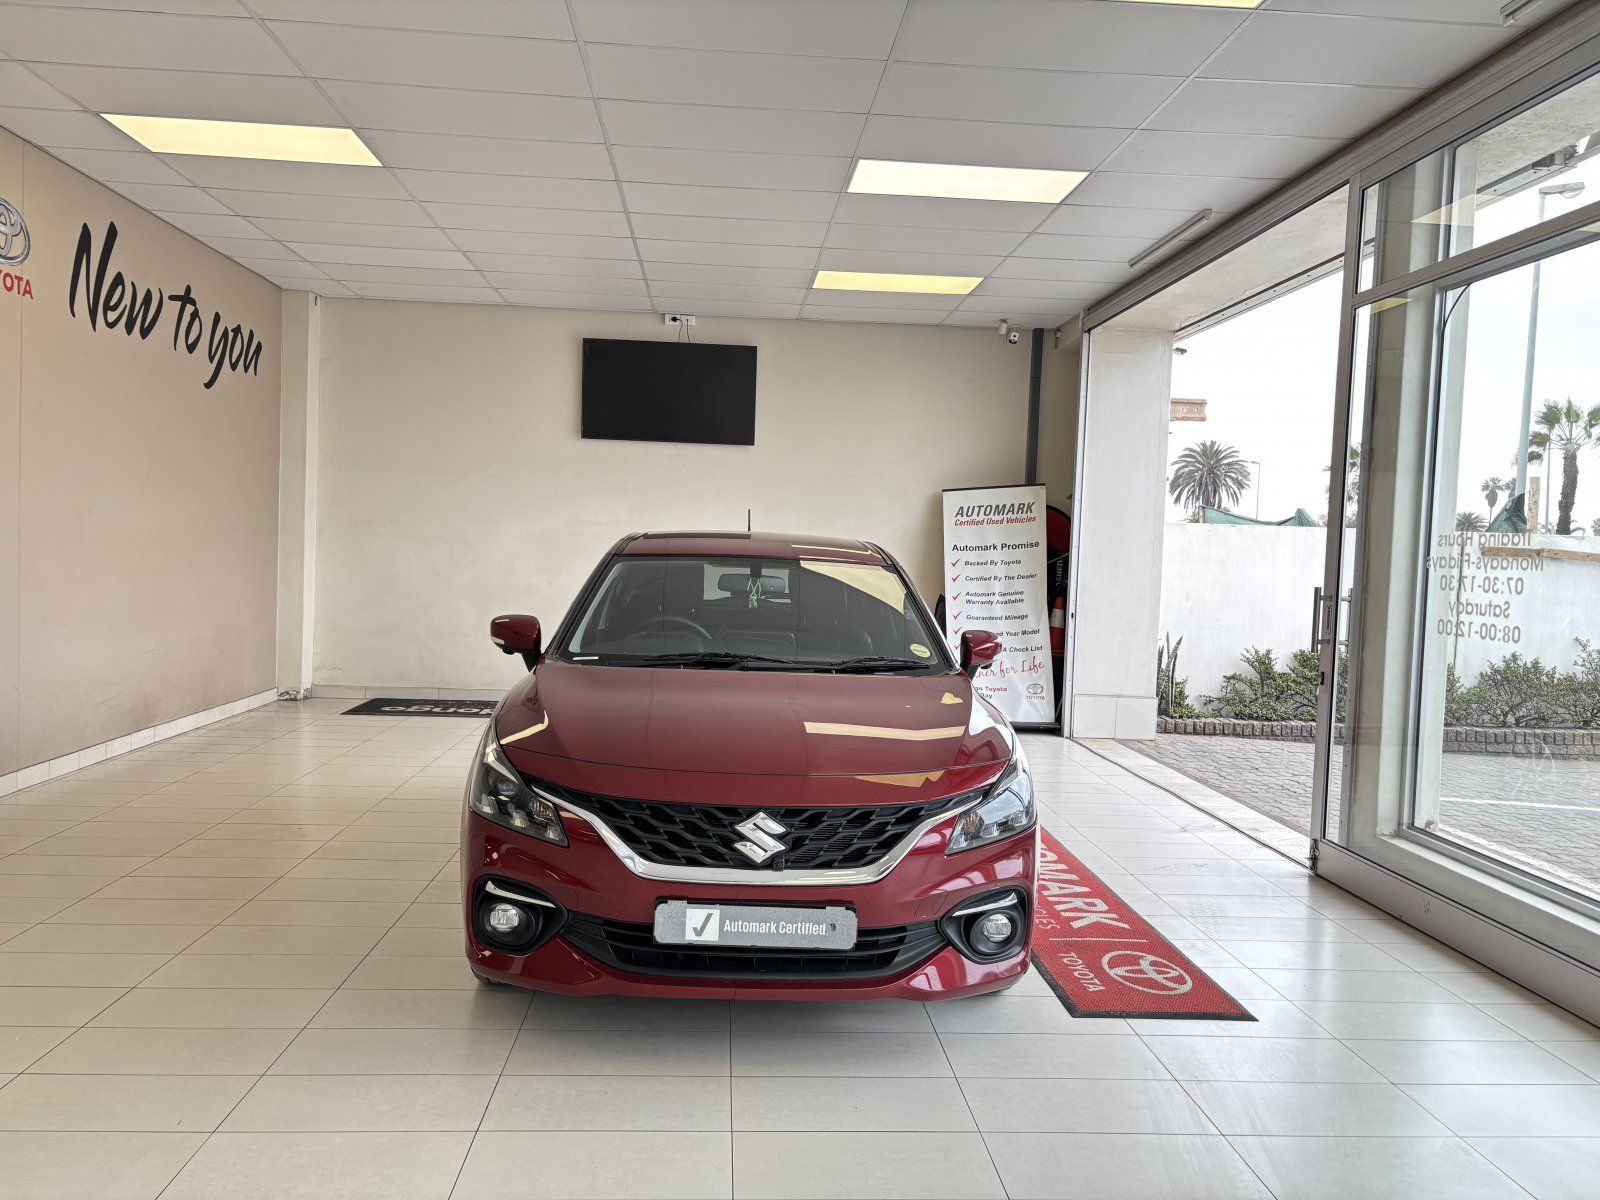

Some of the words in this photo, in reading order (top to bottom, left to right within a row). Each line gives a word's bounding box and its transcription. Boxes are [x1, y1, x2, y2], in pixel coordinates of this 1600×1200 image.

[0, 271, 34, 300] OTA
[69, 221, 164, 340] New
[168, 285, 202, 354] to
[203, 311, 263, 389] you
[955, 502, 1036, 518] AUTOMARK
[954, 518, 985, 527] Certified
[986, 517, 1004, 525] Used
[1006, 515, 1037, 525] Vehicles
[952, 543, 998, 552] Automark
[1001, 541, 1040, 551] Promise
[995, 597, 1024, 605] Available
[1005, 613, 1028, 621] Mileage
[1021, 628, 1040, 636] Model
[999, 661, 1017, 678] for
[1021, 656, 1044, 673] Life
[724, 919, 776, 935] Automark
[779, 921, 826, 935] Certified
[1058, 952, 1105, 991] TOYOTA
